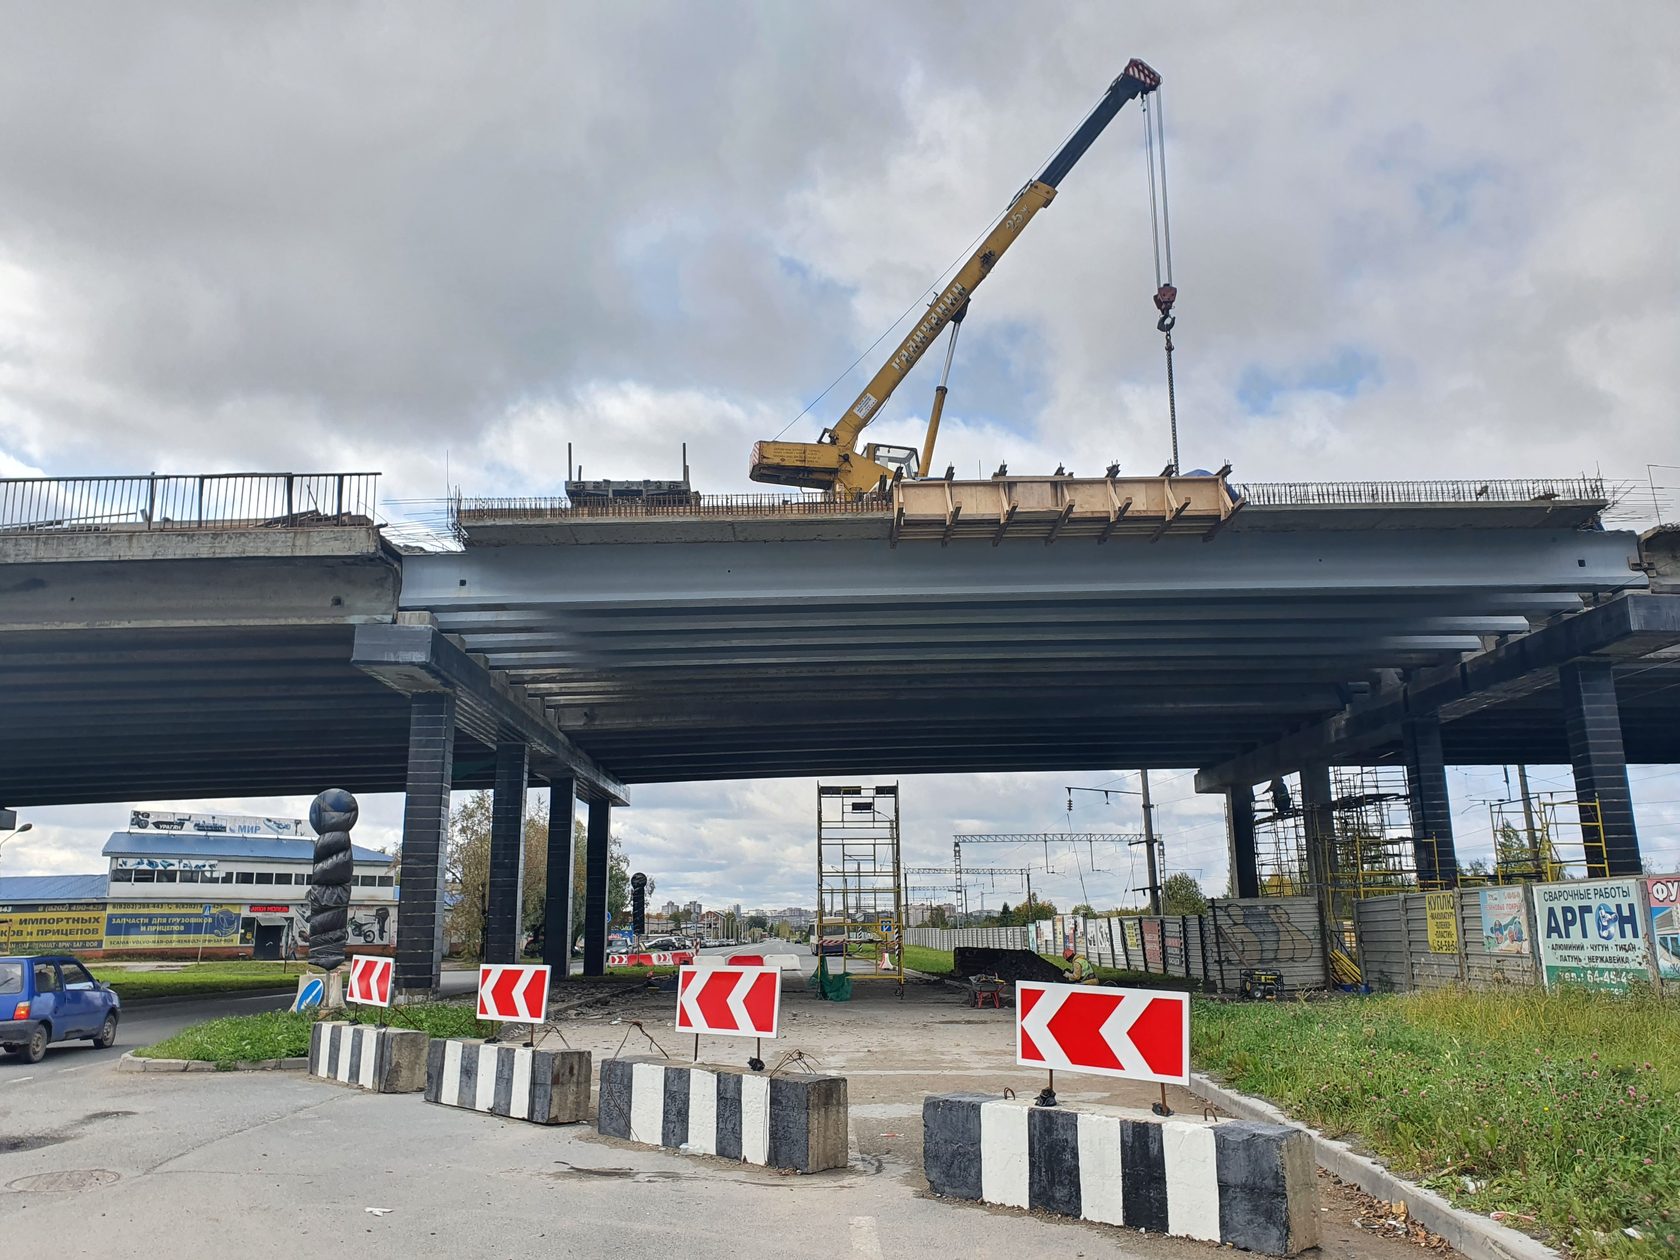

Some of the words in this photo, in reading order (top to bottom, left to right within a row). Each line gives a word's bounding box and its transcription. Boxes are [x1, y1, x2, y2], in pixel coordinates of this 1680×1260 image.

[891, 282, 968, 371] ГАЛИЧАНИН
[237, 824, 260, 834] МИР
[1543, 888, 1592, 902] СВАРОЧНЫЕ
[1593, 886, 1631, 900] РАБОТЫ
[1427, 894, 1454, 911] КУПЛЮ
[19, 917, 101, 926] ИМПОРТНЫХ
[1546, 903, 1640, 940] АРГОН
[37, 928, 99, 937] ПРИЦЕПОВ
[1551, 943, 1585, 951] АЛЮМИНИЙ
[1590, 944, 1609, 952] ЧУГУН
[1560, 954, 1583, 963] ЛАТУНЬ
[1587, 954, 1630, 964] НЕРЖАВЕЙКА
